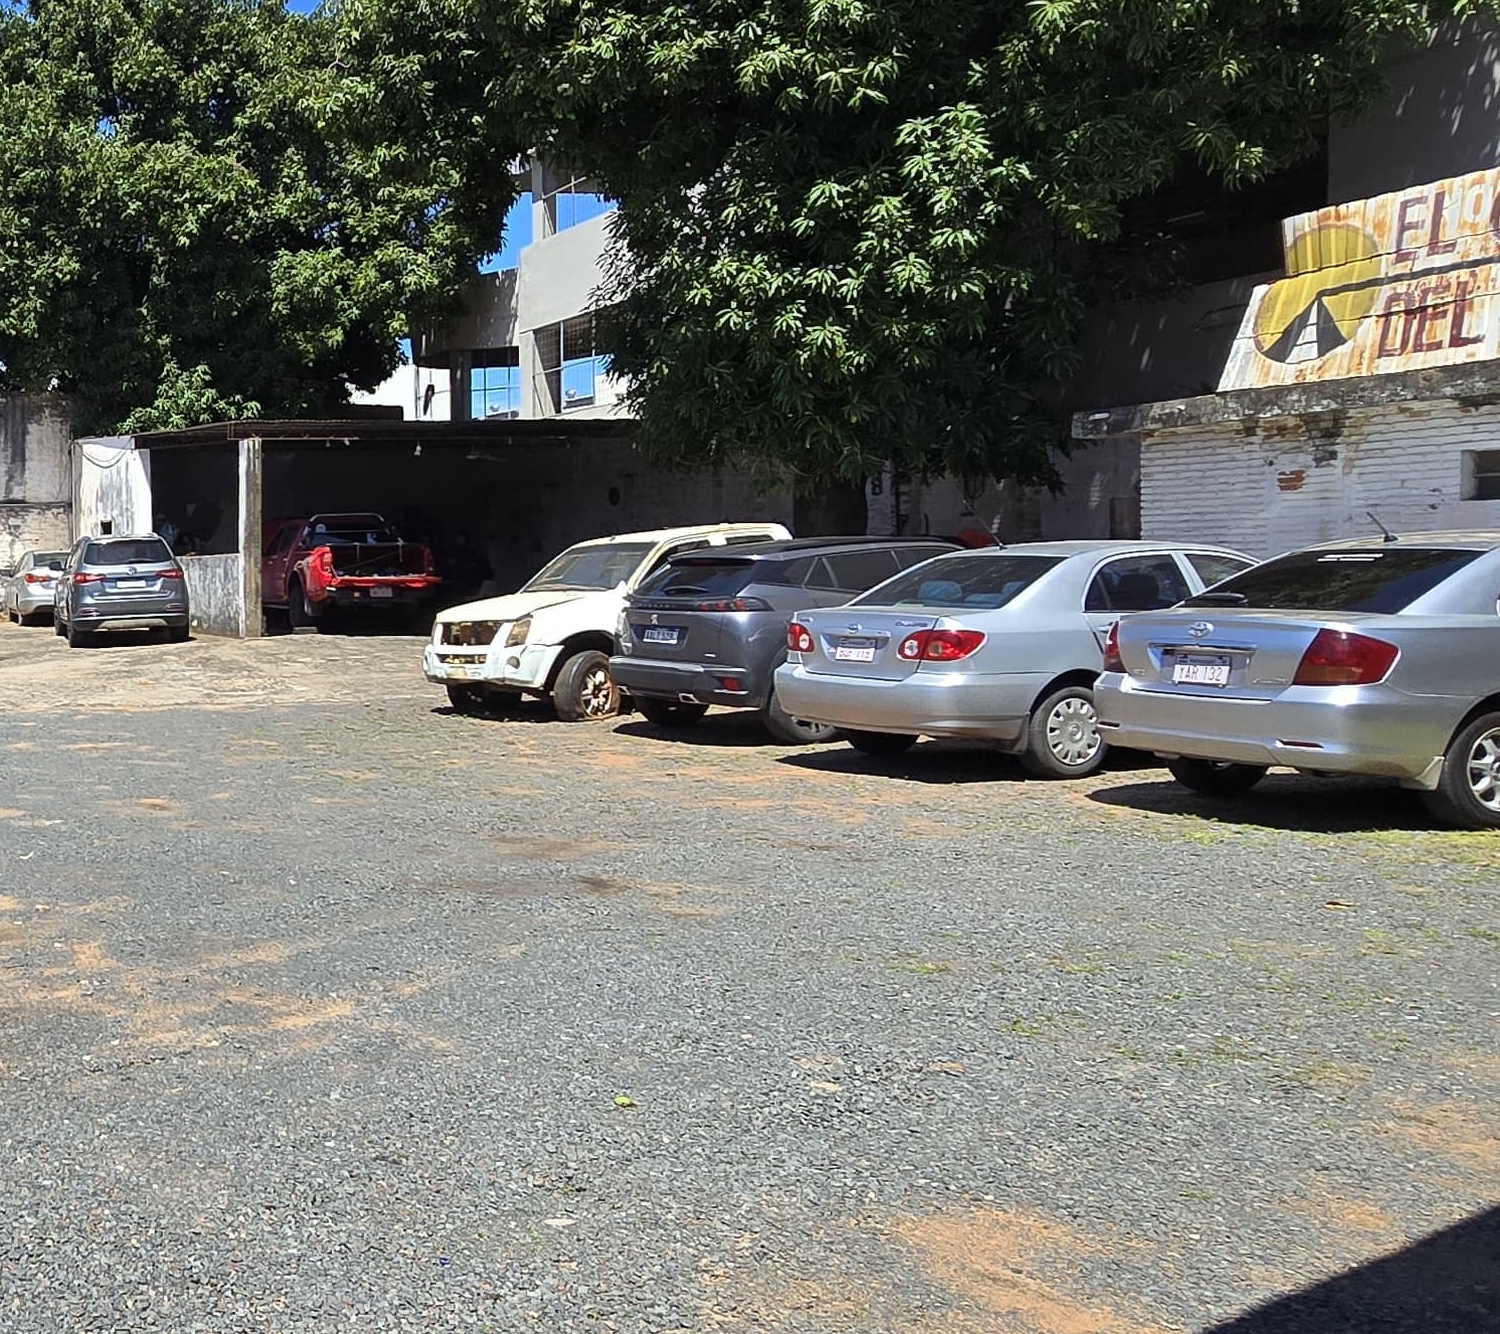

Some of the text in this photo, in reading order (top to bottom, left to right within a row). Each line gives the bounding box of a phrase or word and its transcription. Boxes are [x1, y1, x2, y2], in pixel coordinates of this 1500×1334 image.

[1395, 191, 1457, 264] EL
[1377, 280, 1485, 358] DEL
[1203, 666, 1223, 682] 132
